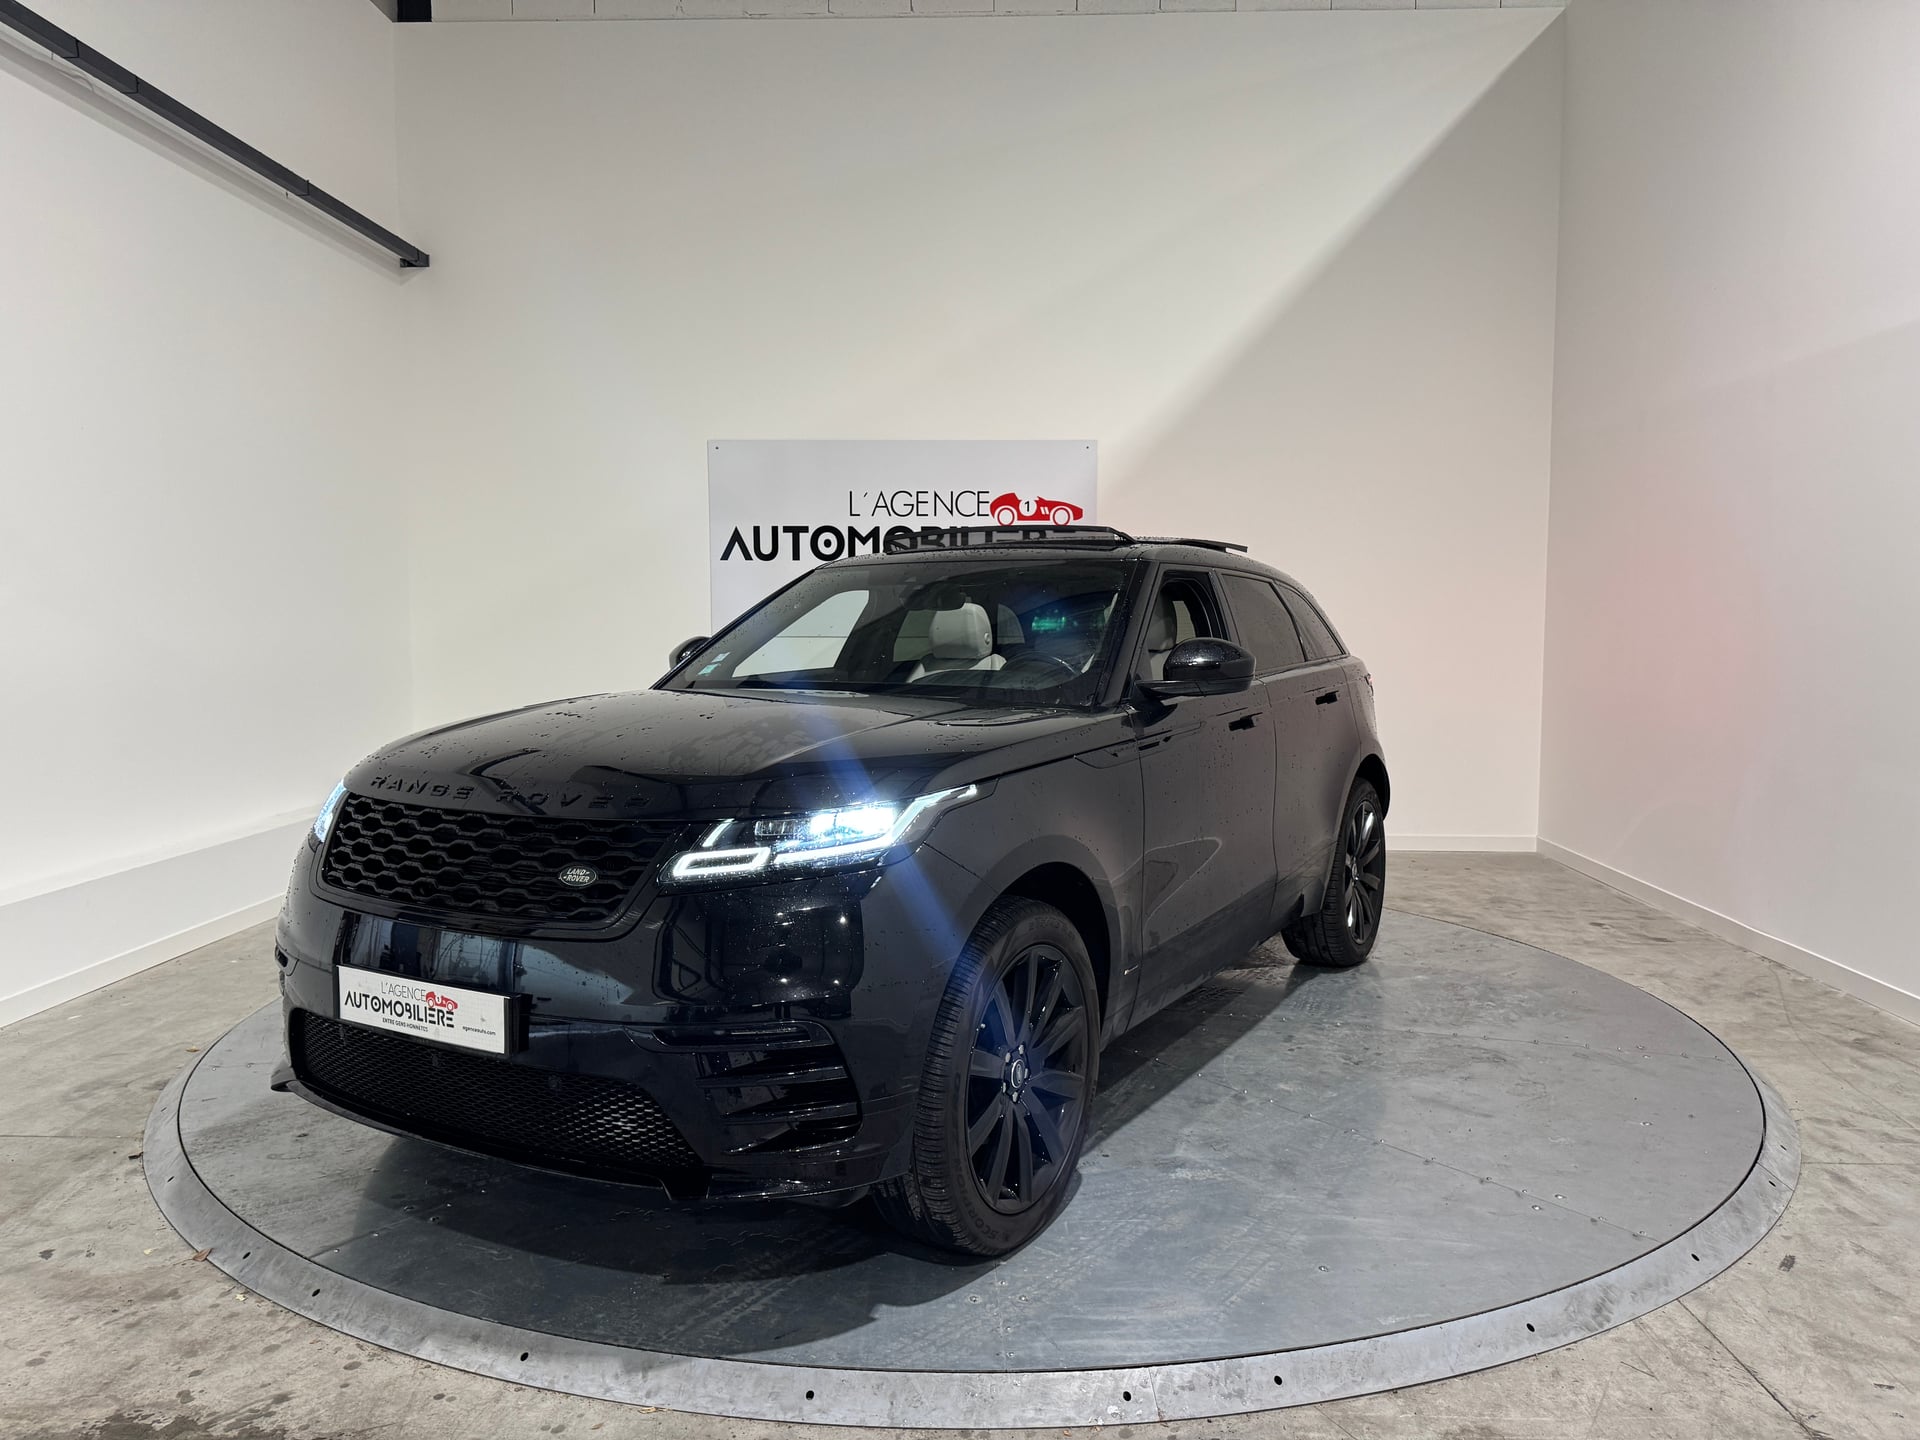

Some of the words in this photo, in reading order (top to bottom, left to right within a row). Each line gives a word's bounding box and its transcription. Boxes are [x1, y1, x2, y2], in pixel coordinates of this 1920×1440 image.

[1024, 500, 1030, 512] 1
[370, 775, 475, 801] RANGE
[496, 786, 651, 809] ROVER
[381, 981, 427, 1003] L'AGENCE
